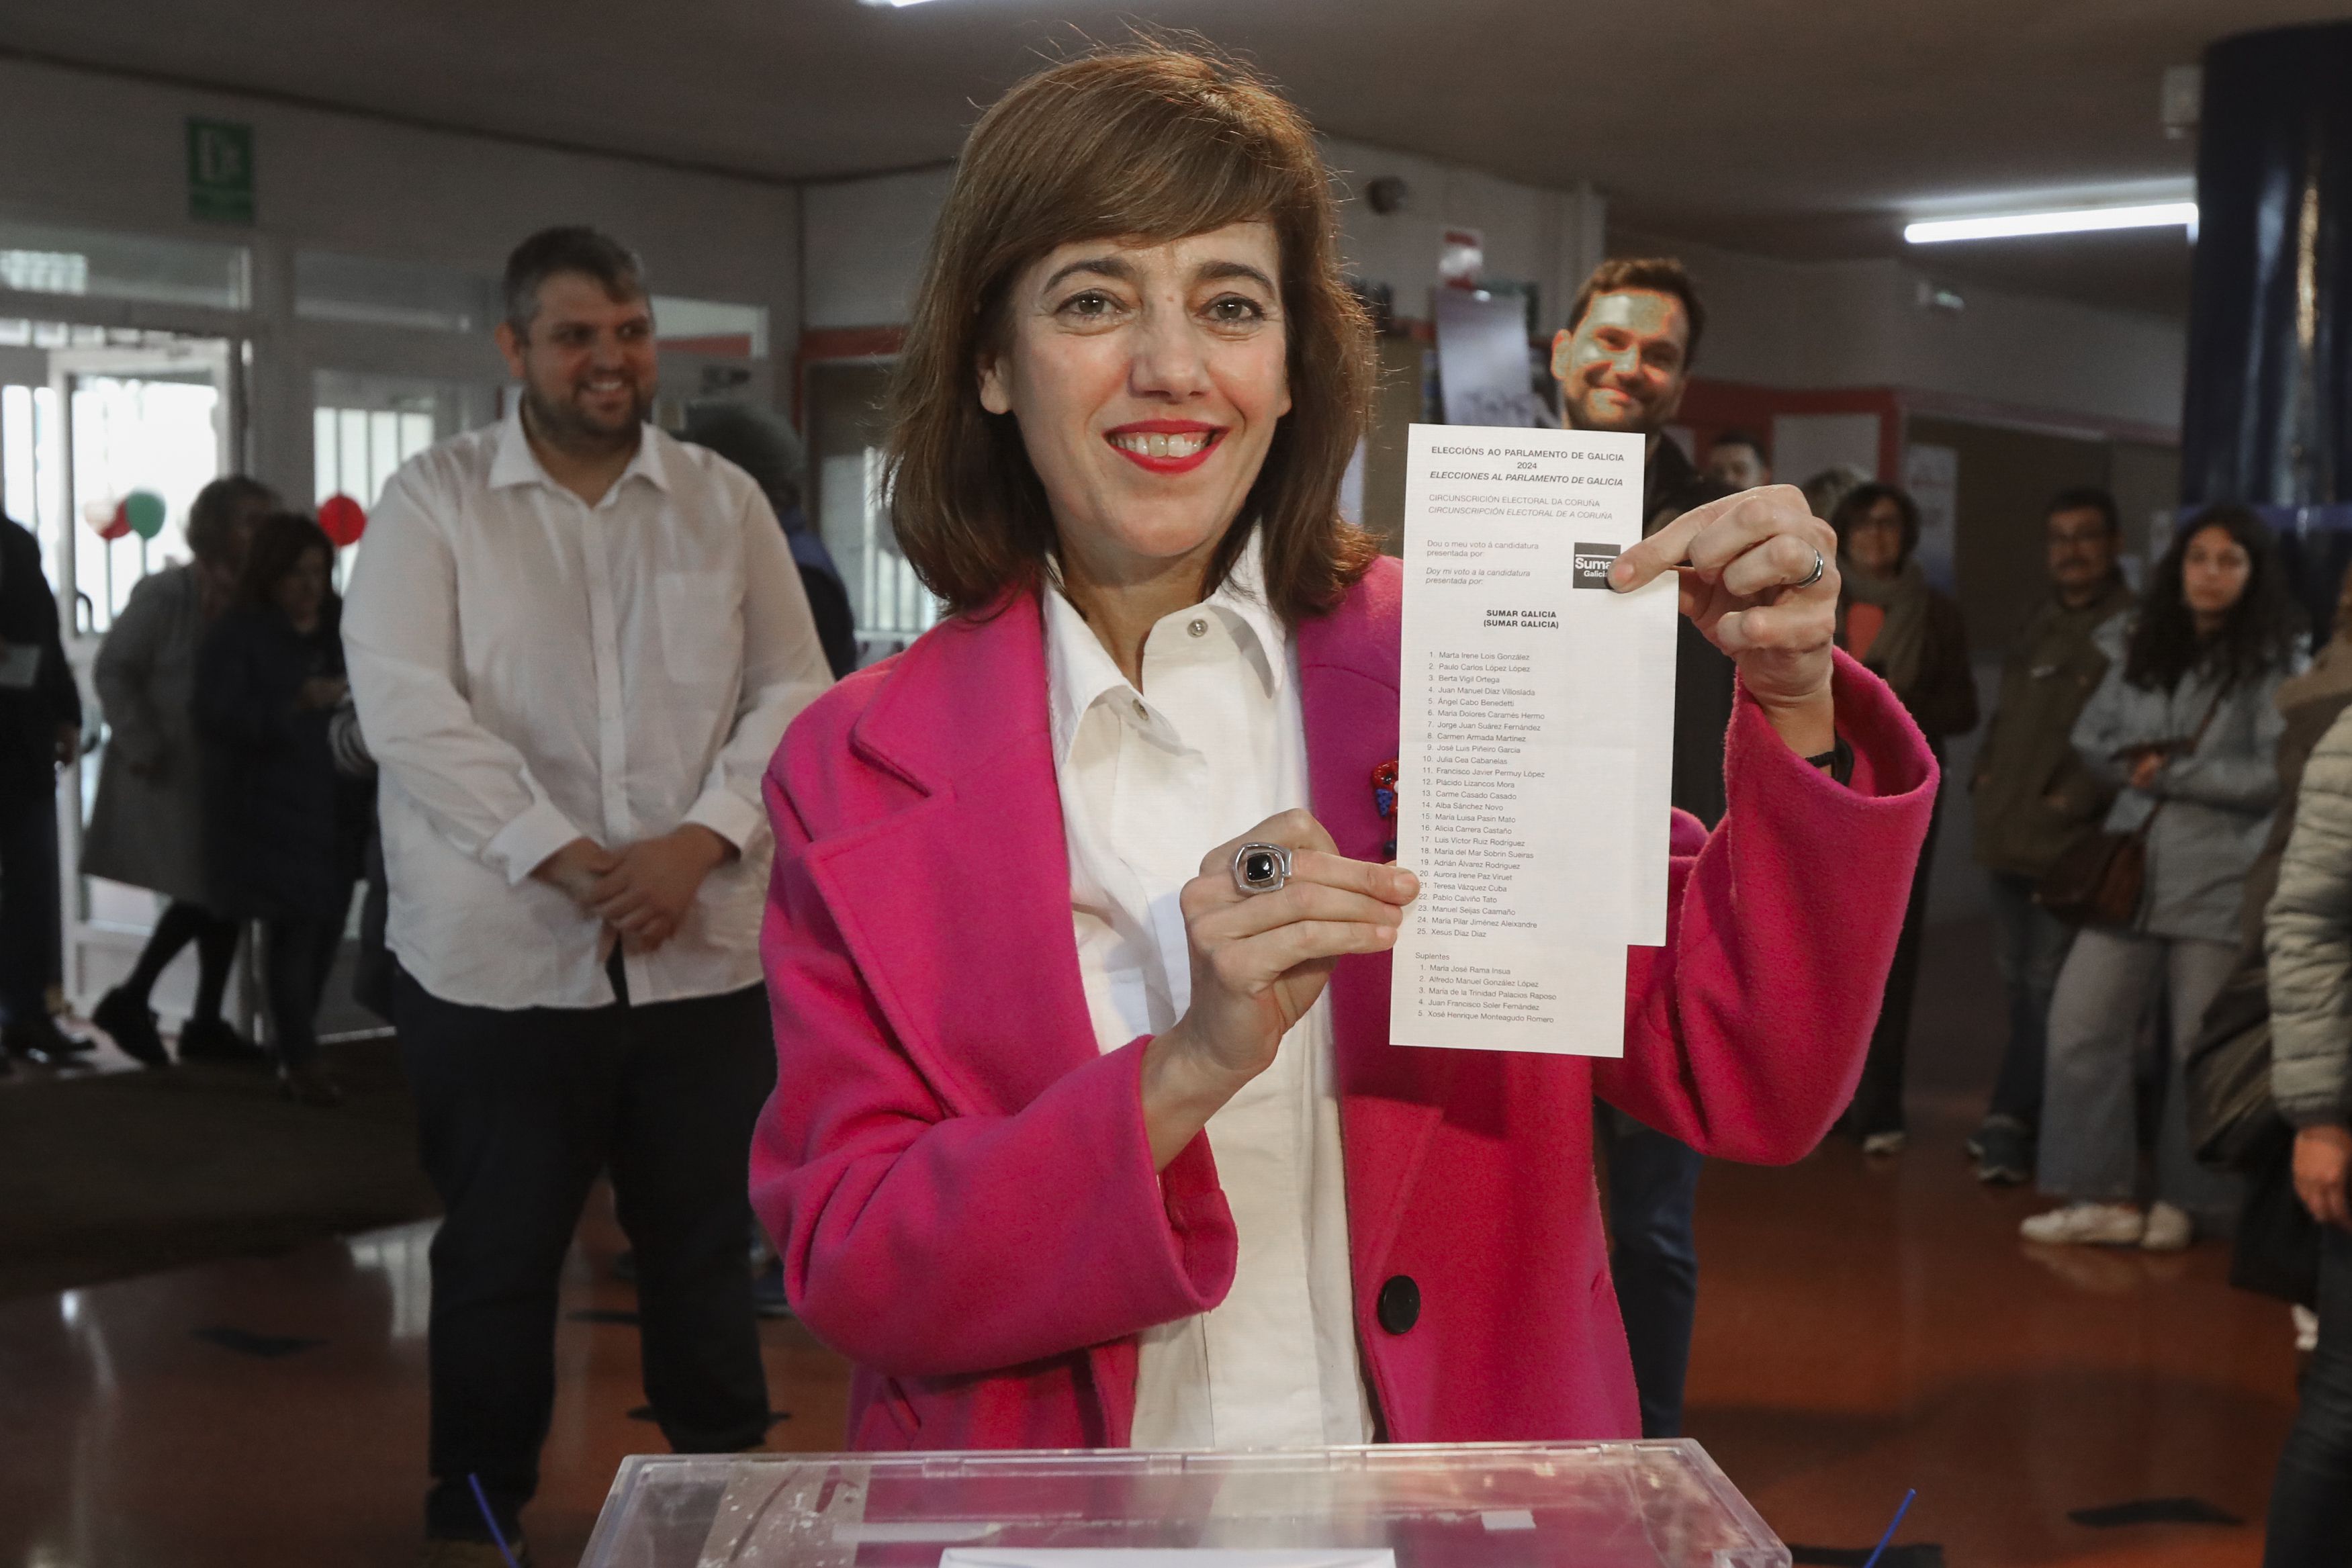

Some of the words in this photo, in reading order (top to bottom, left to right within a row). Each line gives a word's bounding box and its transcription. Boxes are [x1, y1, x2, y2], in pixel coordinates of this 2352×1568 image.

[1431, 446, 1484, 455] ELECCIÓNS
[1487, 449, 1502, 457] AO
[1504, 449, 1568, 459] PARLAMENTO
[1571, 451, 1584, 459] DE
[1587, 452, 1624, 461] GALICIA
[1517, 461, 1537, 469] 2024
[1430, 471, 1490, 480] ELECCIONES
[1490, 473, 1503, 481] AL
[1505, 473, 1570, 483] PARLAMENTO
[1571, 476, 1585, 484] DE
[1586, 477, 1623, 486] GALICIA
[1429, 494, 1500, 503] CIRCUNSCRICIÓN
[1502, 496, 1549, 505] ELECTORAL
[1551, 498, 1563, 506] DA
[1564, 498, 1600, 507] CORUÑA
[1428, 506, 1505, 516] CIRCUNSCRIPCIÓN
[1506, 508, 1553, 517] ELECTORAL
[1555, 510, 1568, 518] DE
[1576, 511, 1613, 520] CORUÑA
[1427, 539, 1443, 547] Dou
[1494, 542, 1539, 550] candidatura
[1427, 549, 1468, 557] presentada
[1575, 557, 1612, 569] Sum
[1426, 567, 1441, 576] Doy
[1425, 577, 1467, 585] presentada
[1486, 609, 1519, 617] SUMAR
[1483, 619, 1518, 627] (SUMAR
[1521, 620, 1559, 629] GALICIA)
[1496, 653, 1530, 661] González
[1439, 663, 1459, 671] Paulo
[1460, 663, 1484, 672] Carlos
[1485, 664, 1507, 673] López
[1438, 674, 1458, 682] Berta
[1459, 675, 1474, 684] Vigil
[1476, 676, 1500, 685] Ortega
[1459, 698, 1480, 706] Cabo
[1459, 710, 1487, 718] Dolores
[1437, 721, 1457, 730] Jorge
[1504, 723, 1541, 731] Fernández
[1437, 732, 1465, 740] Carmen
[1466, 733, 1494, 741] Armada
[1470, 757, 1508, 765] Cabanelas
[1436, 767, 1471, 776] Francisco
[1472, 768, 1494, 776] Javier
[1494, 769, 1522, 778] Permuy
[1523, 770, 1545, 778] López
[1435, 790, 1459, 798] Carme
[1461, 790, 1488, 799] Casado
[1489, 792, 1517, 800] Casado
[1453, 802, 1484, 811] Sánchez
[1484, 803, 1504, 811] Novo
[1456, 814, 1476, 822] Luisa
[1498, 815, 1516, 823] Mato
[1455, 825, 1482, 833] Carrera
[1482, 826, 1512, 835] Castaño
[1472, 837, 1488, 845] Ruiz
[1457, 859, 1484, 868] Álvarez
[1433, 870, 1457, 879] Aurora
[1477, 872, 1491, 880] Paz
[1433, 882, 1456, 890] Teresa
[1488, 884, 1507, 892] Cuba
[1432, 893, 1453, 902] Pablo
[1454, 894, 1481, 903] Calviño
[1432, 905, 1458, 913] Manuel
[1482, 907, 1516, 916] Caamaño
[1453, 917, 1469, 925] Pilar
[1415, 952, 1450, 961] Suplentes
[1450, 965, 1468, 973] José
[1469, 966, 1490, 974] Rama
[1492, 967, 1511, 975] Insua
[1429, 976, 1455, 984] Alfredo
[1455, 977, 1482, 985] Manuel
[1482, 978, 1516, 986] González
[1517, 980, 1539, 988] López
[1449, 988, 1459, 996] de
[1468, 989, 1497, 997] Trinidad
[1498, 990, 1528, 999] Palacios
[1529, 992, 1557, 1001] Raposo
[1447, 999, 1482, 1008] Francisco
[1482, 1001, 1501, 1009] Soler
[1502, 1002, 1540, 1011] Fernández
[1428, 1010, 1446, 1018] Xosé
[1447, 1011, 1479, 1020] Henrique
[1480, 1013, 1525, 1023] Monteagudo
[1526, 1015, 1554, 1023] Romero
